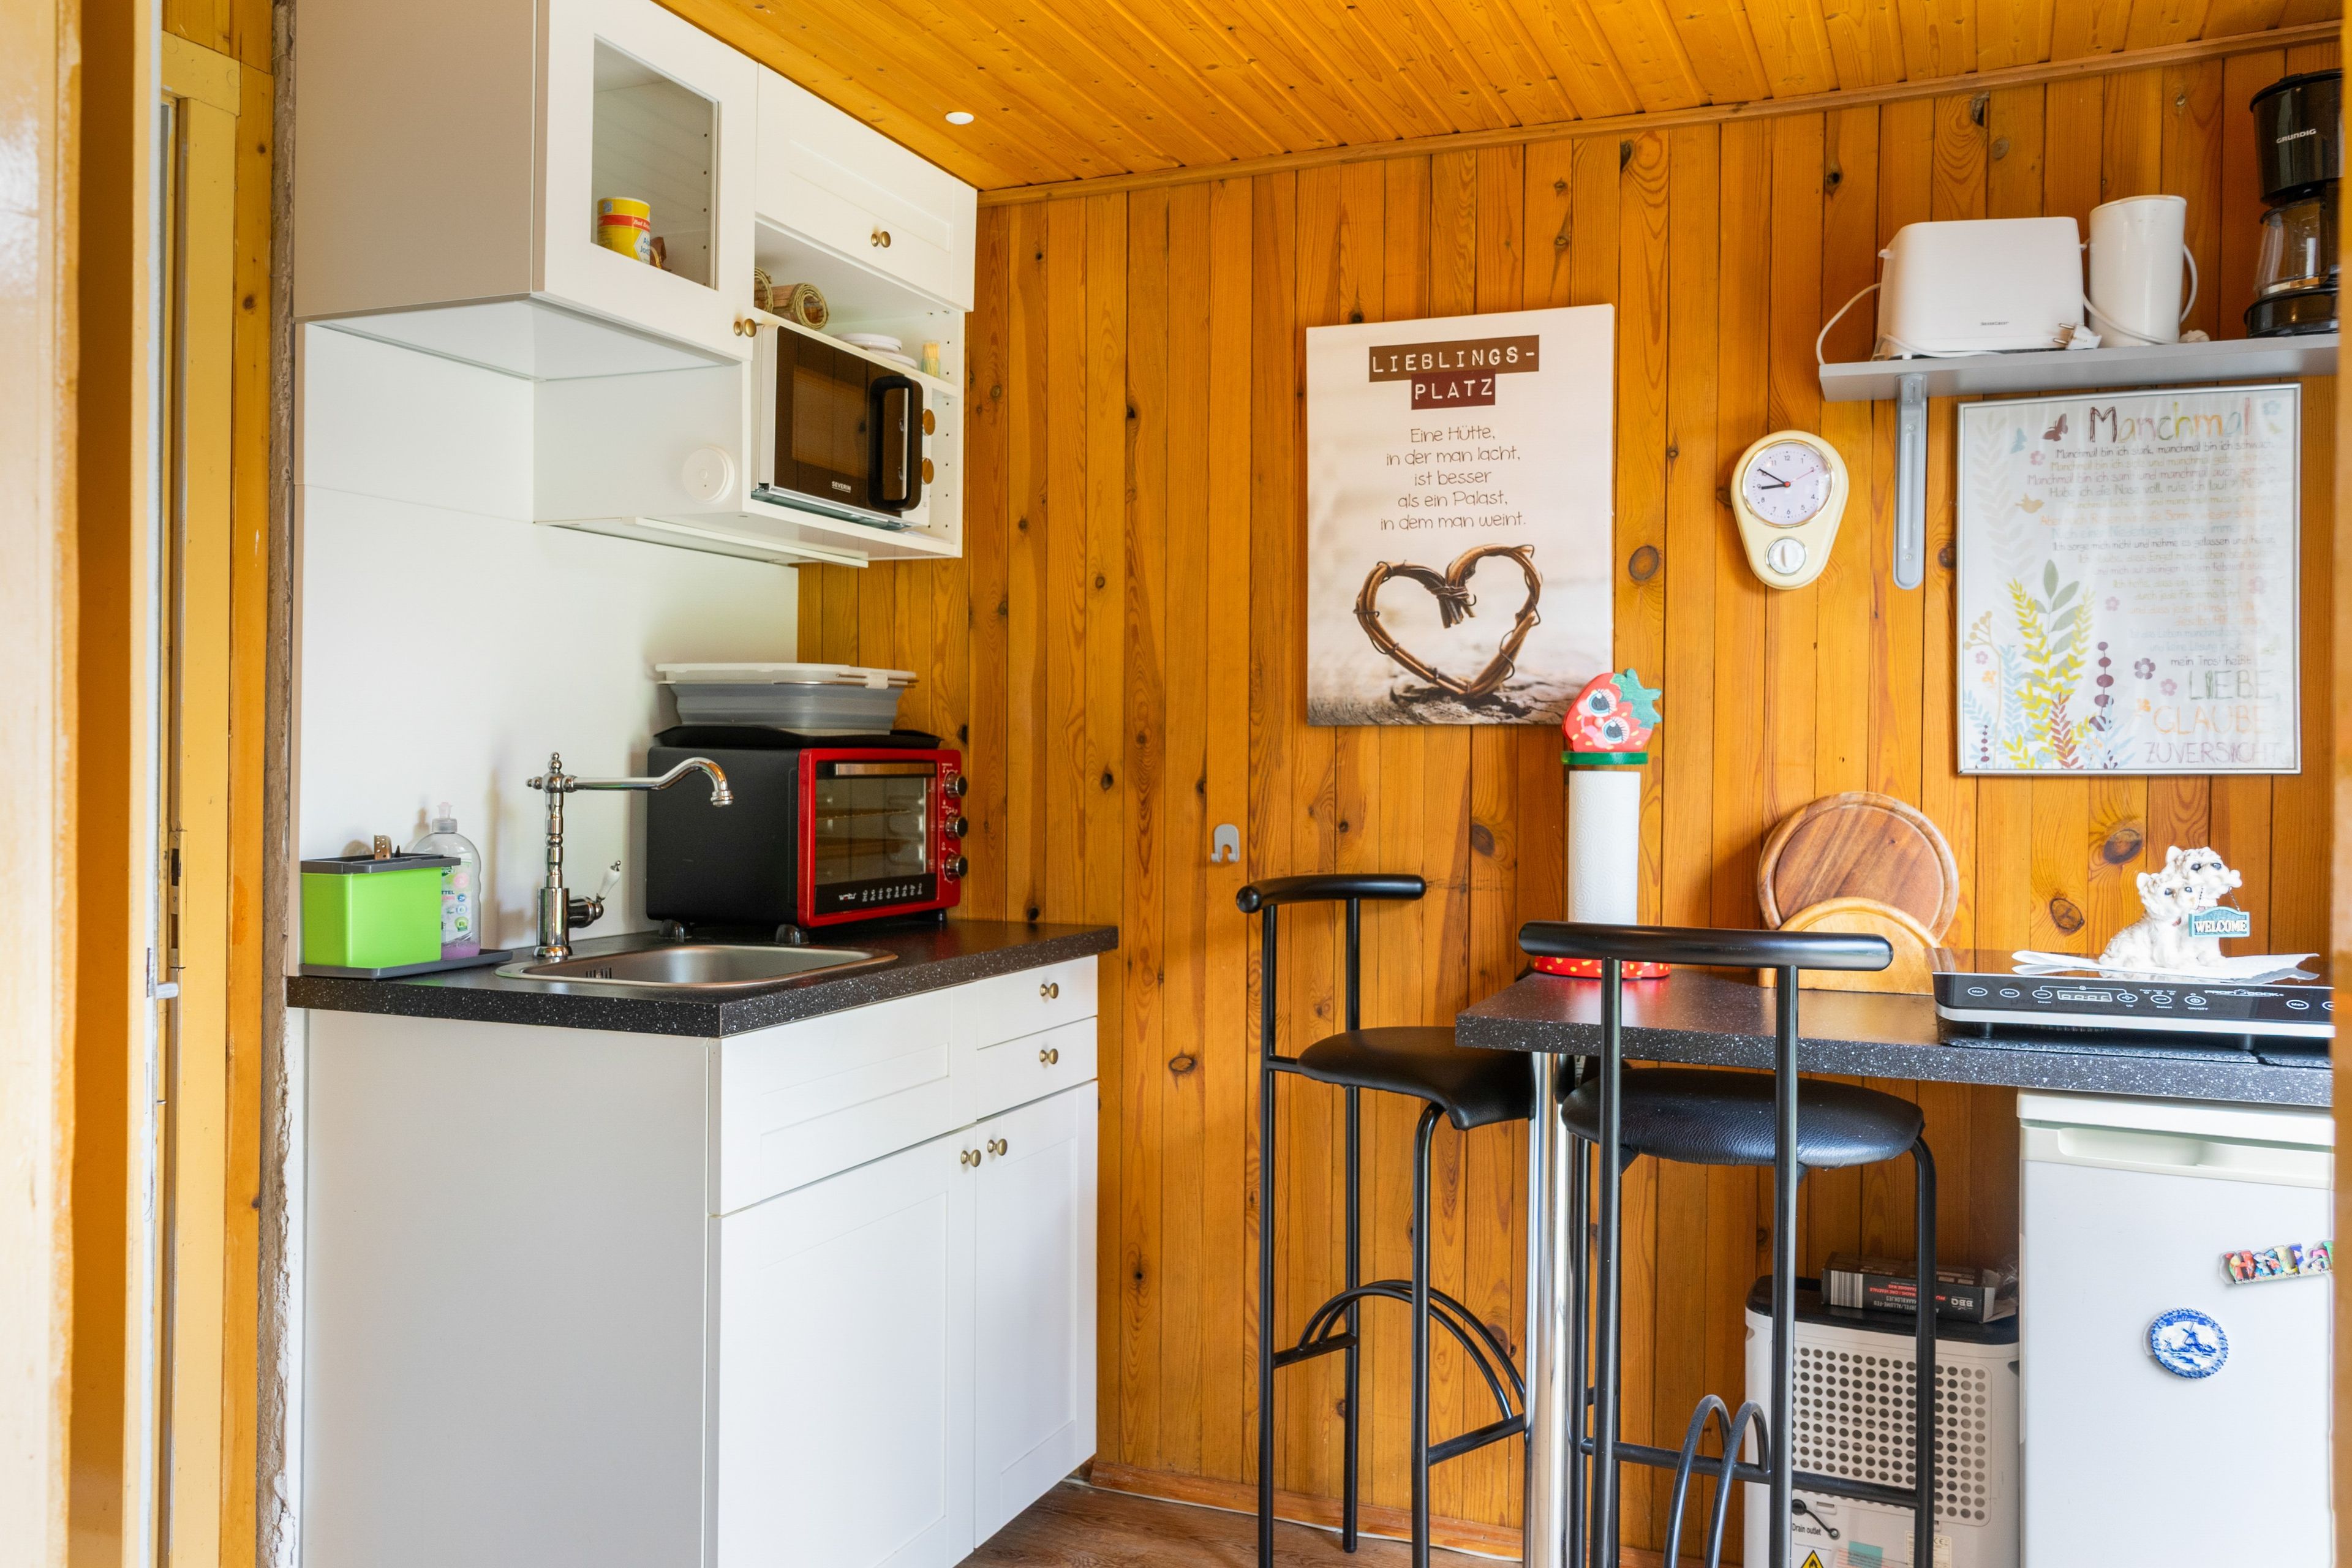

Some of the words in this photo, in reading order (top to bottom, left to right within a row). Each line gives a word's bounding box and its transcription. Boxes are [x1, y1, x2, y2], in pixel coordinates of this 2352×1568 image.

[2276, 129, 2316, 144] GRUNDIG
[1373, 346, 1535, 372] LIEBLINGS-
[1415, 378, 1493, 400] PLATZ
[2089, 398, 2251, 443] Manchmal
[1411, 428, 1443, 443] Eine
[1449, 425, 1496, 440] Hütte,
[1386, 454, 1400, 466] in
[1404, 449, 1431, 466] der
[1436, 451, 1472, 462] man
[1477, 445, 1520, 461] lacht,
[2056, 447, 2098, 458] Manchmal
[2101, 447, 2113, 457] bin
[2116, 447, 2129, 456] ich
[2157, 441, 2201, 454] manchmal
[2204, 441, 2217, 452] bin
[2220, 440, 2233, 450] ich
[1414, 471, 1432, 486] ist
[1437, 470, 1491, 485] besser
[2027, 472, 2074, 485] Manchmal
[2095, 472, 2109, 482] ich
[2160, 467, 2208, 479] manchmal
[832, 481, 851, 491] SEVERIN
[1398, 494, 1420, 508] als
[1425, 495, 1448, 507] ein
[1453, 490, 1508, 506] Palast,
[1381, 518, 1394, 530] in
[1399, 514, 1433, 530] dem
[1438, 516, 1474, 529] man
[1479, 511, 1526, 527] weint.
[2067, 543, 2089, 552] sorge
[2112, 540, 2131, 549] nicht
[2134, 539, 2149, 549] und
[2152, 537, 2179, 548] nehme
[2170, 655, 2193, 666] mein
[2198, 655, 2221, 666] Trost
[2144, 742, 2280, 764] ZUVERSICHT
[2195, 920, 2247, 933] WELCOME
[1951, 1297, 1973, 1308] BBQ
[1792, 1523, 1806, 1532] Drain
[1807, 1526, 1822, 1536] outlet
